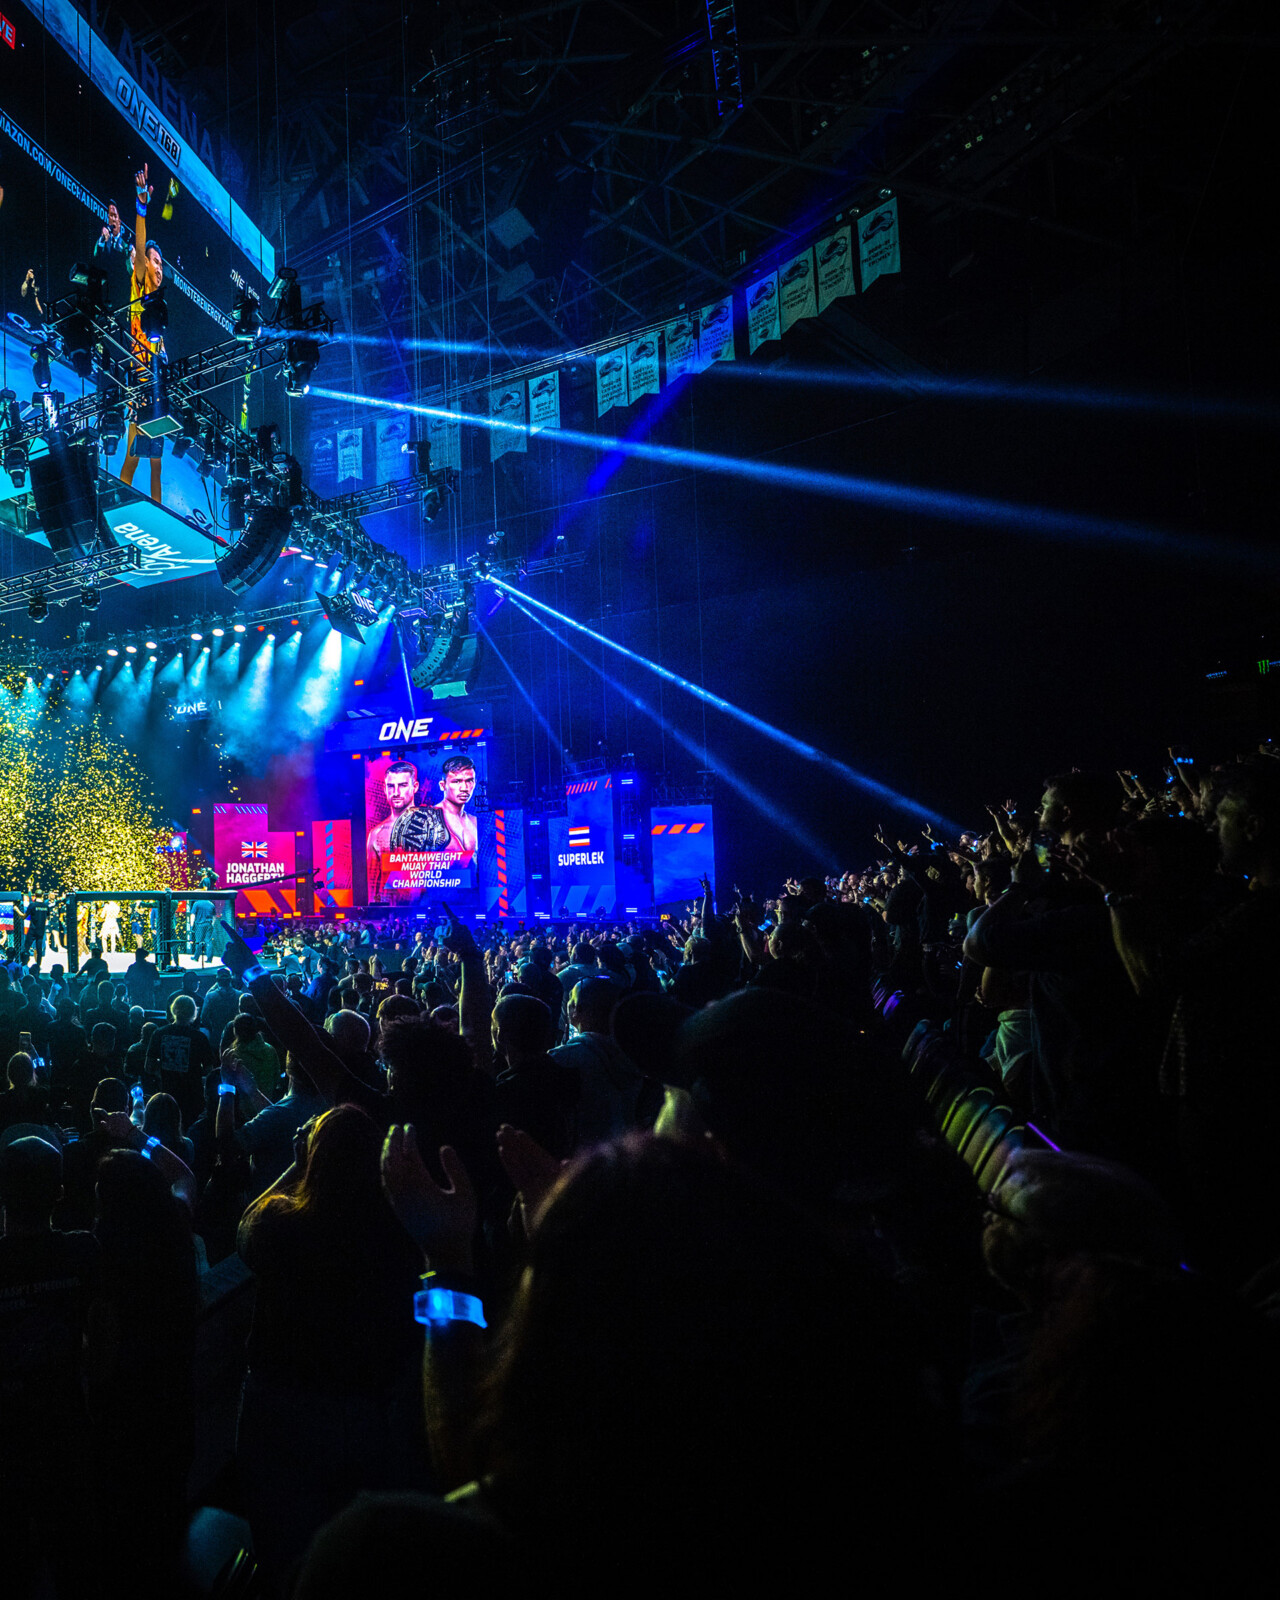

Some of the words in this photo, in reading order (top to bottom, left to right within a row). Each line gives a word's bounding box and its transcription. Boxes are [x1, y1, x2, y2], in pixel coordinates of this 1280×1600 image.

[116, 77, 159, 141] ONE
[176, 701, 208, 715] ONE
[378, 716, 433, 743] ONE
[389, 852, 463, 863] BANTAMWEIGHT
[558, 851, 605, 866] SUPERLEK
[226, 862, 285, 873] JONATHAN
[401, 862, 427, 871] MUAY
[429, 861, 451, 871] THAI
[409, 870, 442, 879] WORLD
[392, 879, 461, 888] CHAMPIONSHIP
